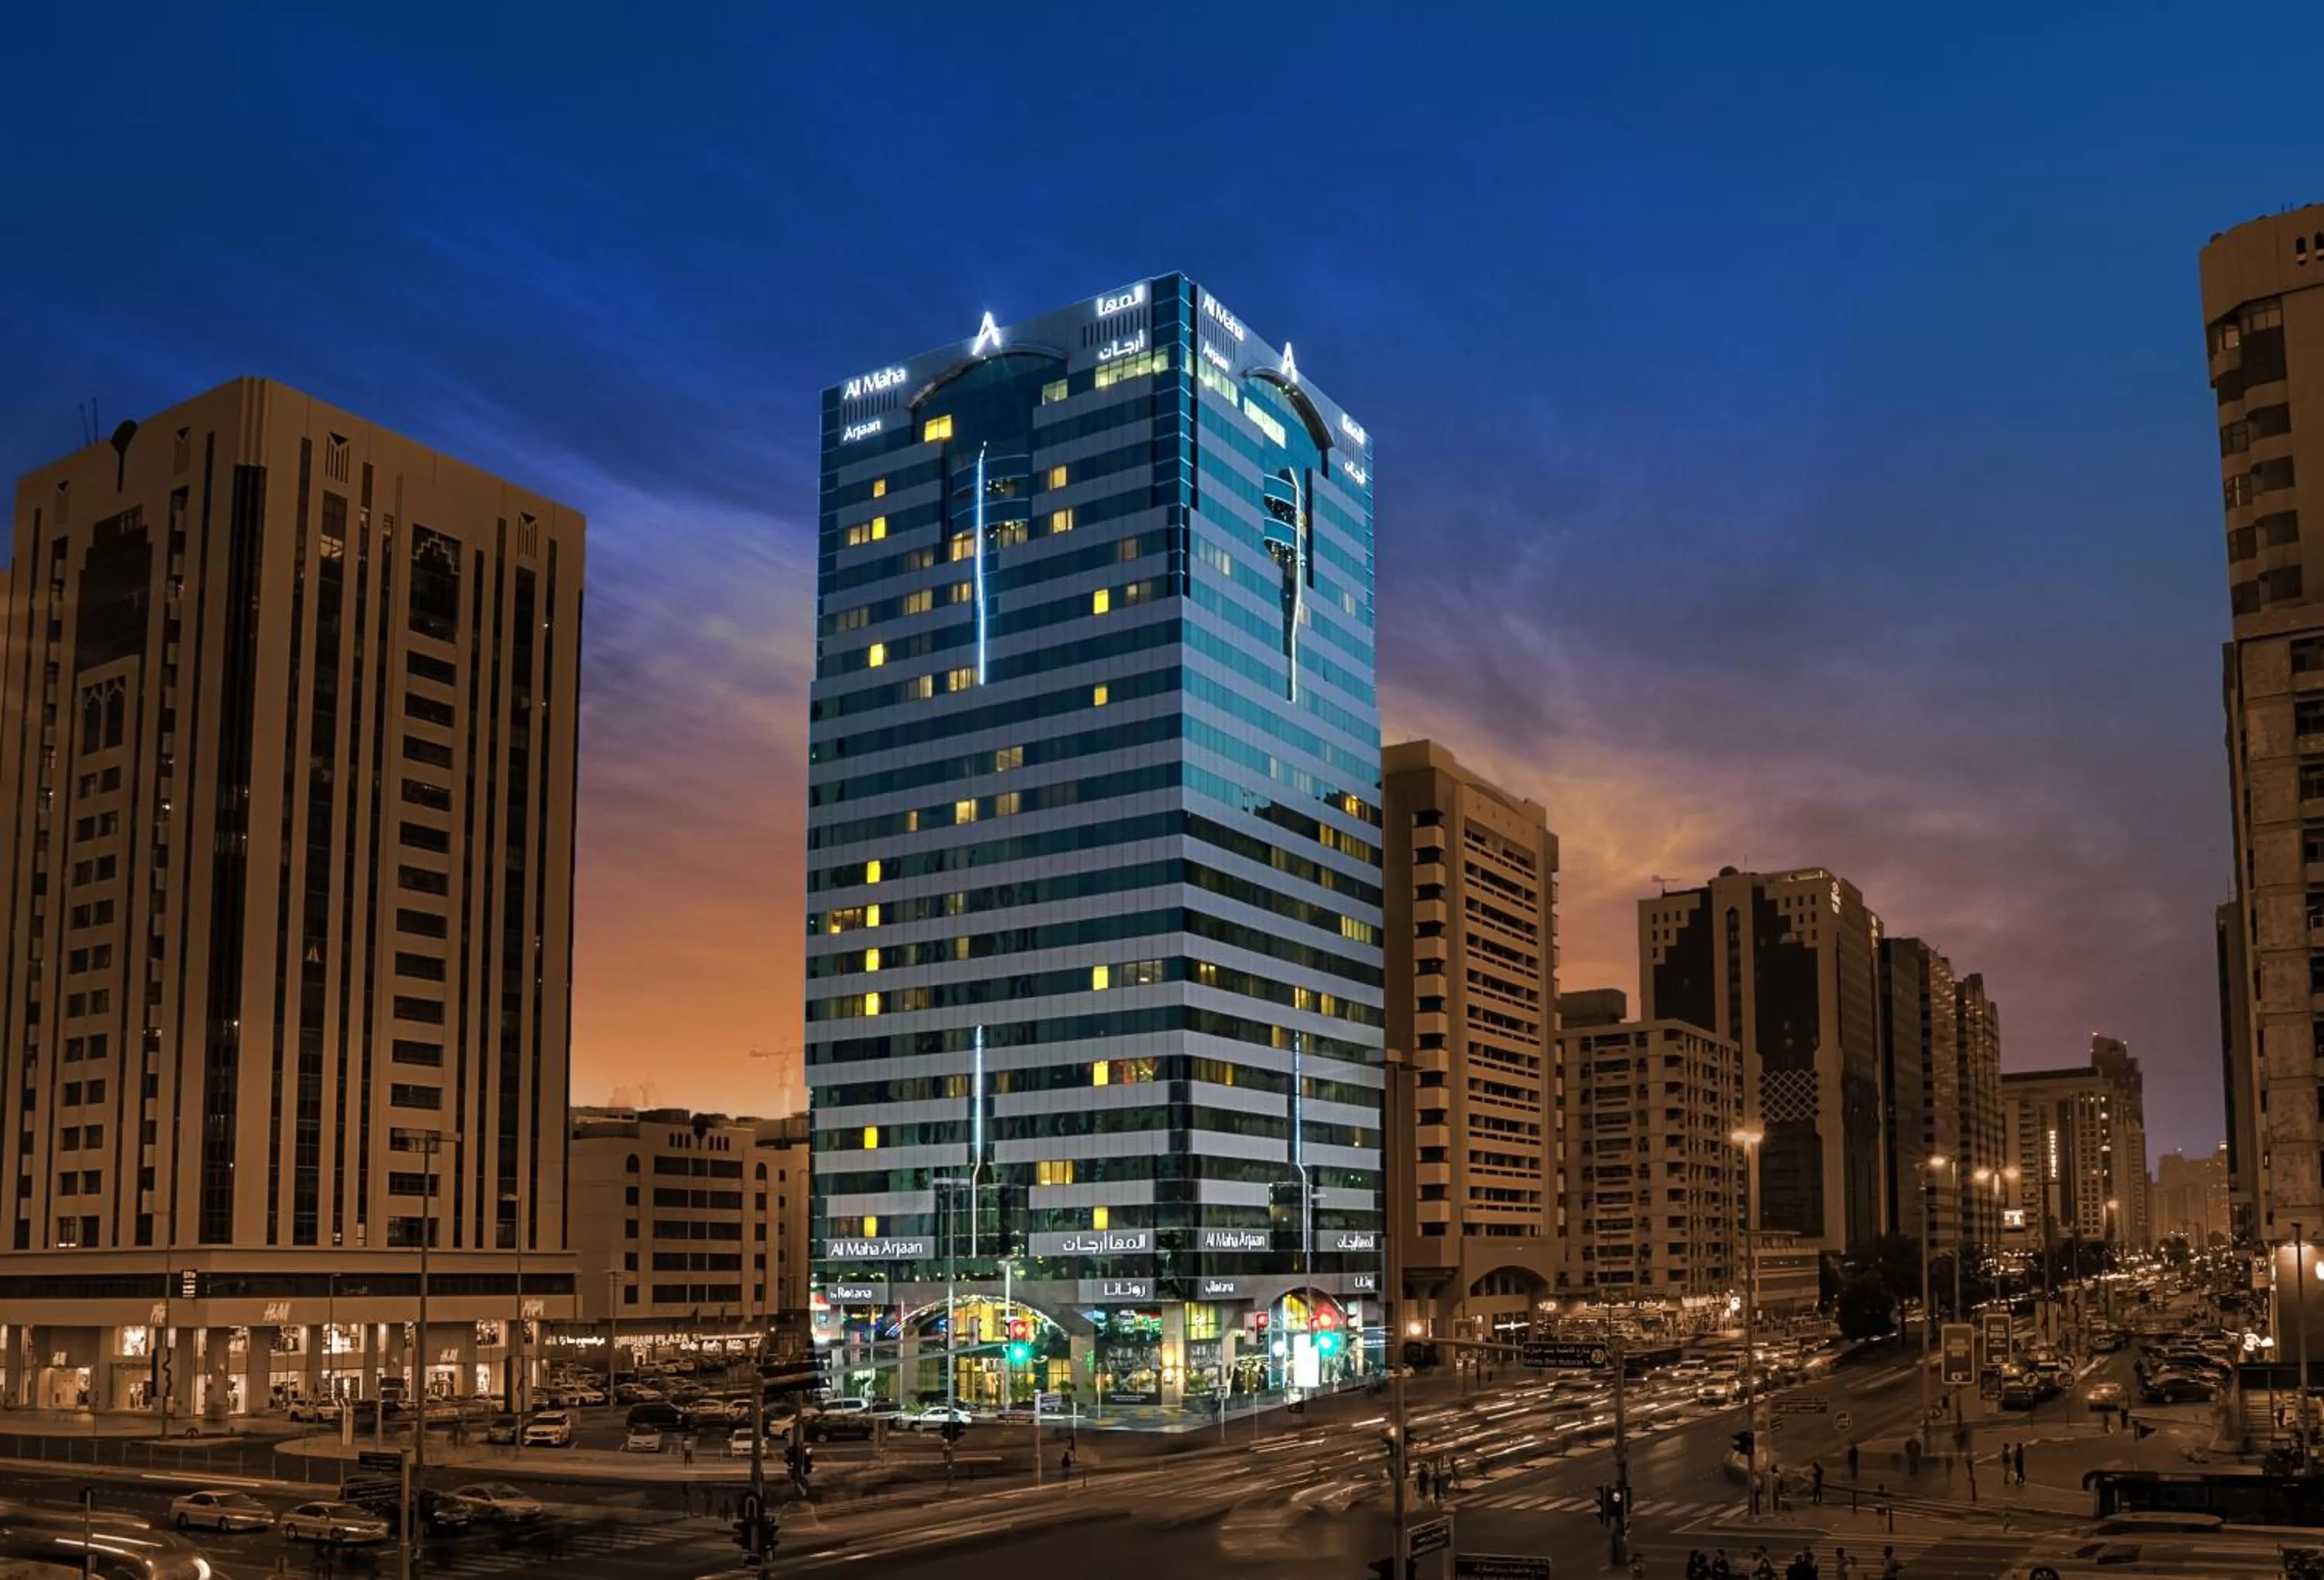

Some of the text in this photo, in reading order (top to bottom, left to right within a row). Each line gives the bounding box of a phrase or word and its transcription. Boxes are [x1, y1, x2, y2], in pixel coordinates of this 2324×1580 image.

[1098, 284, 1144, 316] المها
[844, 367, 906, 400] Al Maha
[844, 419, 881, 441] Arjaan
[830, 1240, 923, 1257] Al Maha Arjaan
[1063, 1230, 1146, 1254] المها أرجان
[1205, 1232, 1215, 1248] Al
[1215, 1232, 1239, 1248] Maha
[837, 1286, 872, 1299] Rotana
[1104, 1282, 1146, 1297] روتانا
